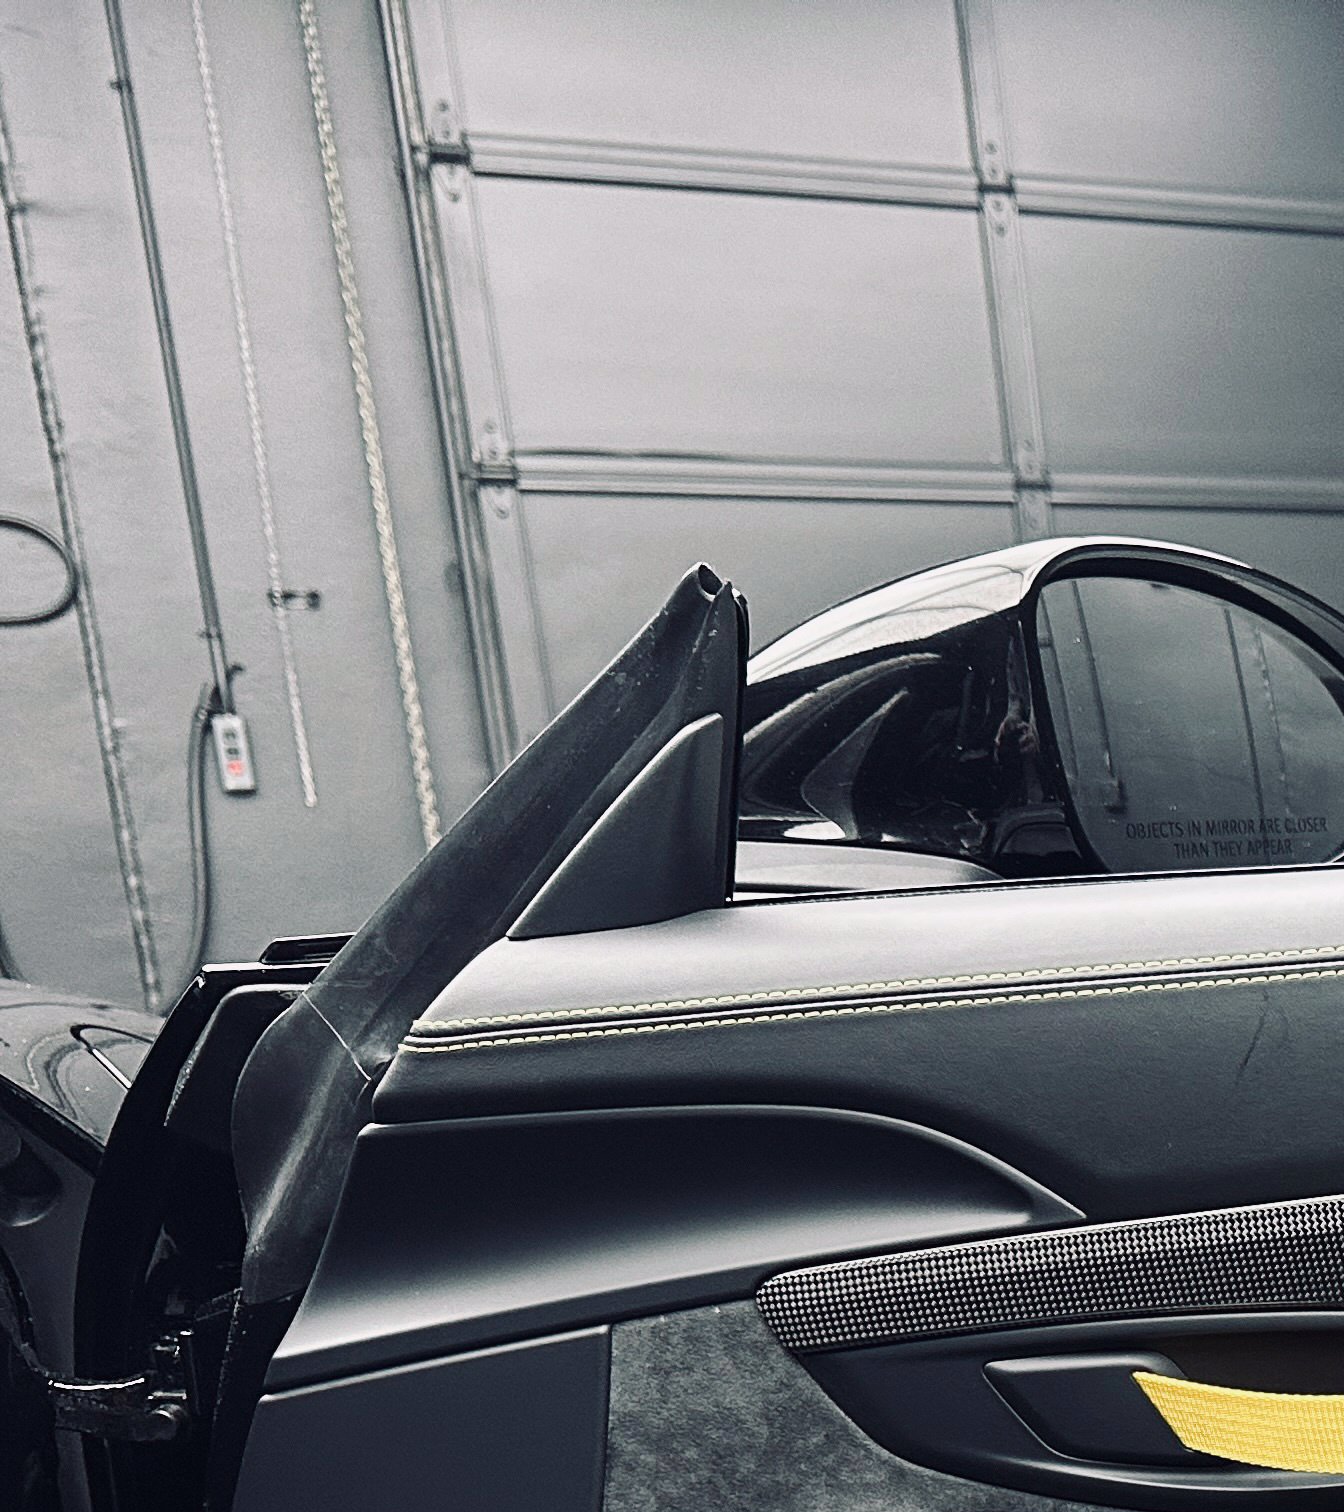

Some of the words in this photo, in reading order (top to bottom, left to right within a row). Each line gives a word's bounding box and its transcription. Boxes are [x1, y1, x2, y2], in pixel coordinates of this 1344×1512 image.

[1126, 822, 1184, 839] OBJECTS
[1188, 820, 1201, 837] IN
[1206, 819, 1255, 836] MIRROR
[1259, 818, 1281, 834] ARE
[1284, 817, 1328, 834] CLOSER
[1174, 842, 1209, 859] THAN
[1213, 840, 1243, 857] THEY
[1247, 838, 1293, 856] APPEAR
